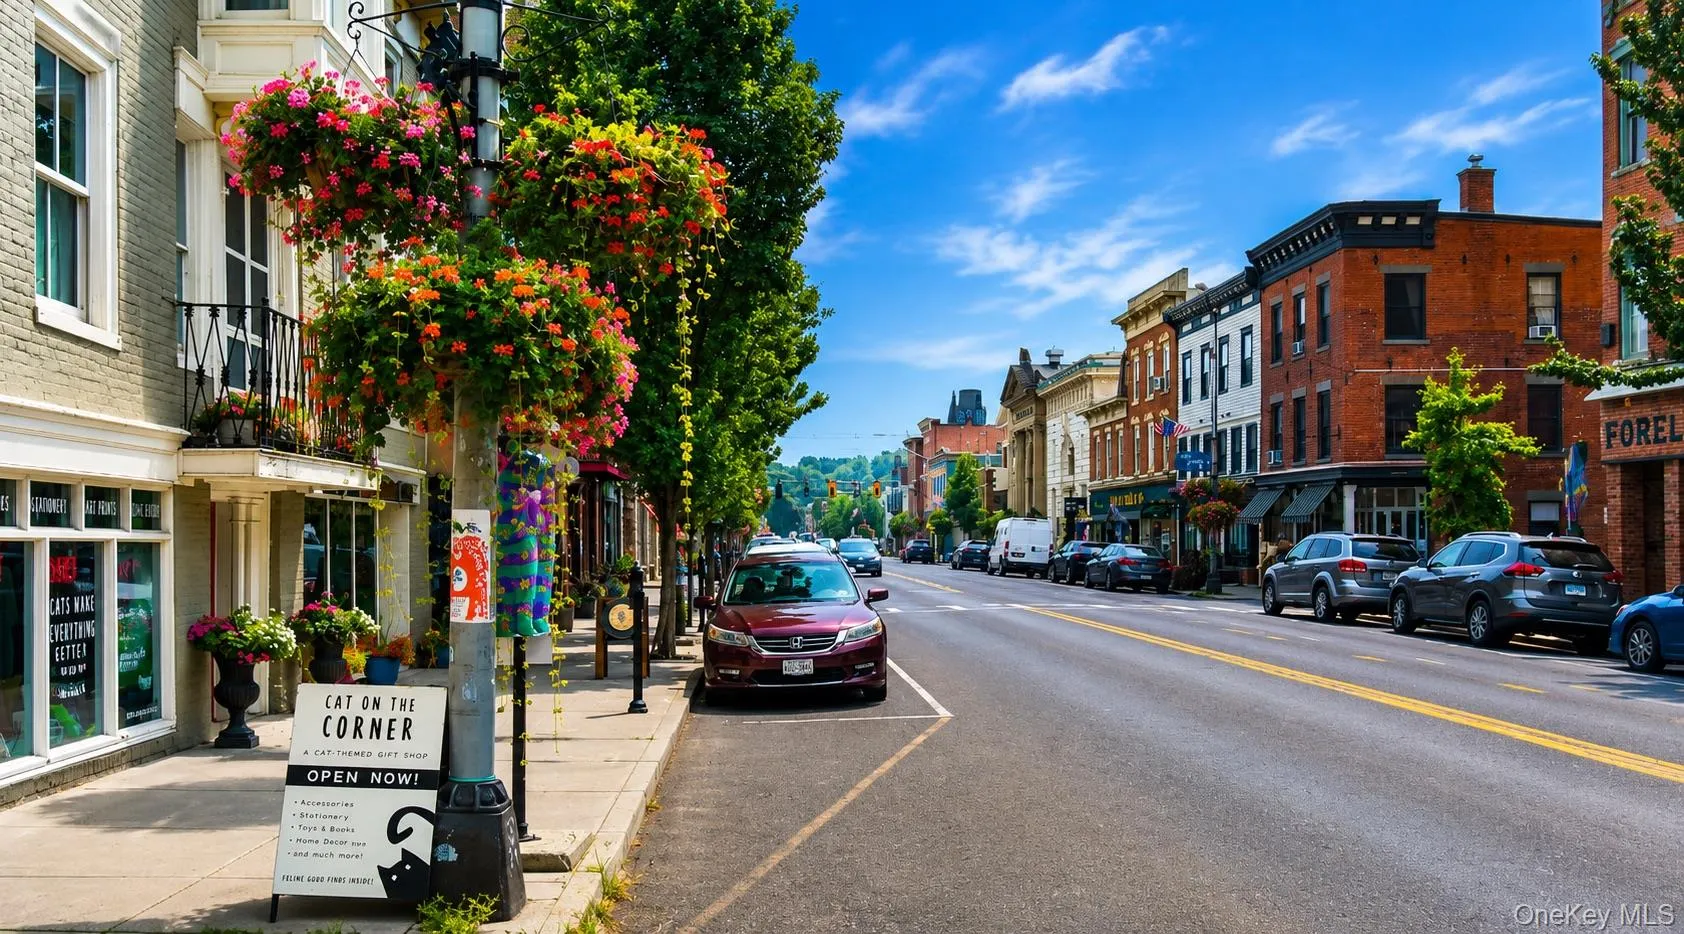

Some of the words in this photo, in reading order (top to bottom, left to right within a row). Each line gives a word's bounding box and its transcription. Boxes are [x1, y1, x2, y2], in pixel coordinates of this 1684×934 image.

[49, 596, 70, 616] CATS
[73, 594, 95, 614] MAKE
[49, 620, 96, 643] EVERYTHING
[325, 694, 353, 710] CAT
[361, 695, 381, 711] ON
[391, 696, 415, 712] THE
[323, 715, 412, 740] CORNER
[314, 749, 373, 758] CAT-THEMED
[377, 751, 399, 759] GIFT
[307, 769, 359, 784] OPEN
[370, 771, 419, 786] NOW!
[301, 800, 354, 808] Accessories
[300, 812, 349, 821] Stationery
[298, 824, 318, 832] Toys
[295, 837, 320, 845] Home
[323, 838, 348, 846] Decor
[293, 850, 309, 858] and
[282, 874, 304, 882] FELINE
[326, 876, 346, 884] FINDS
